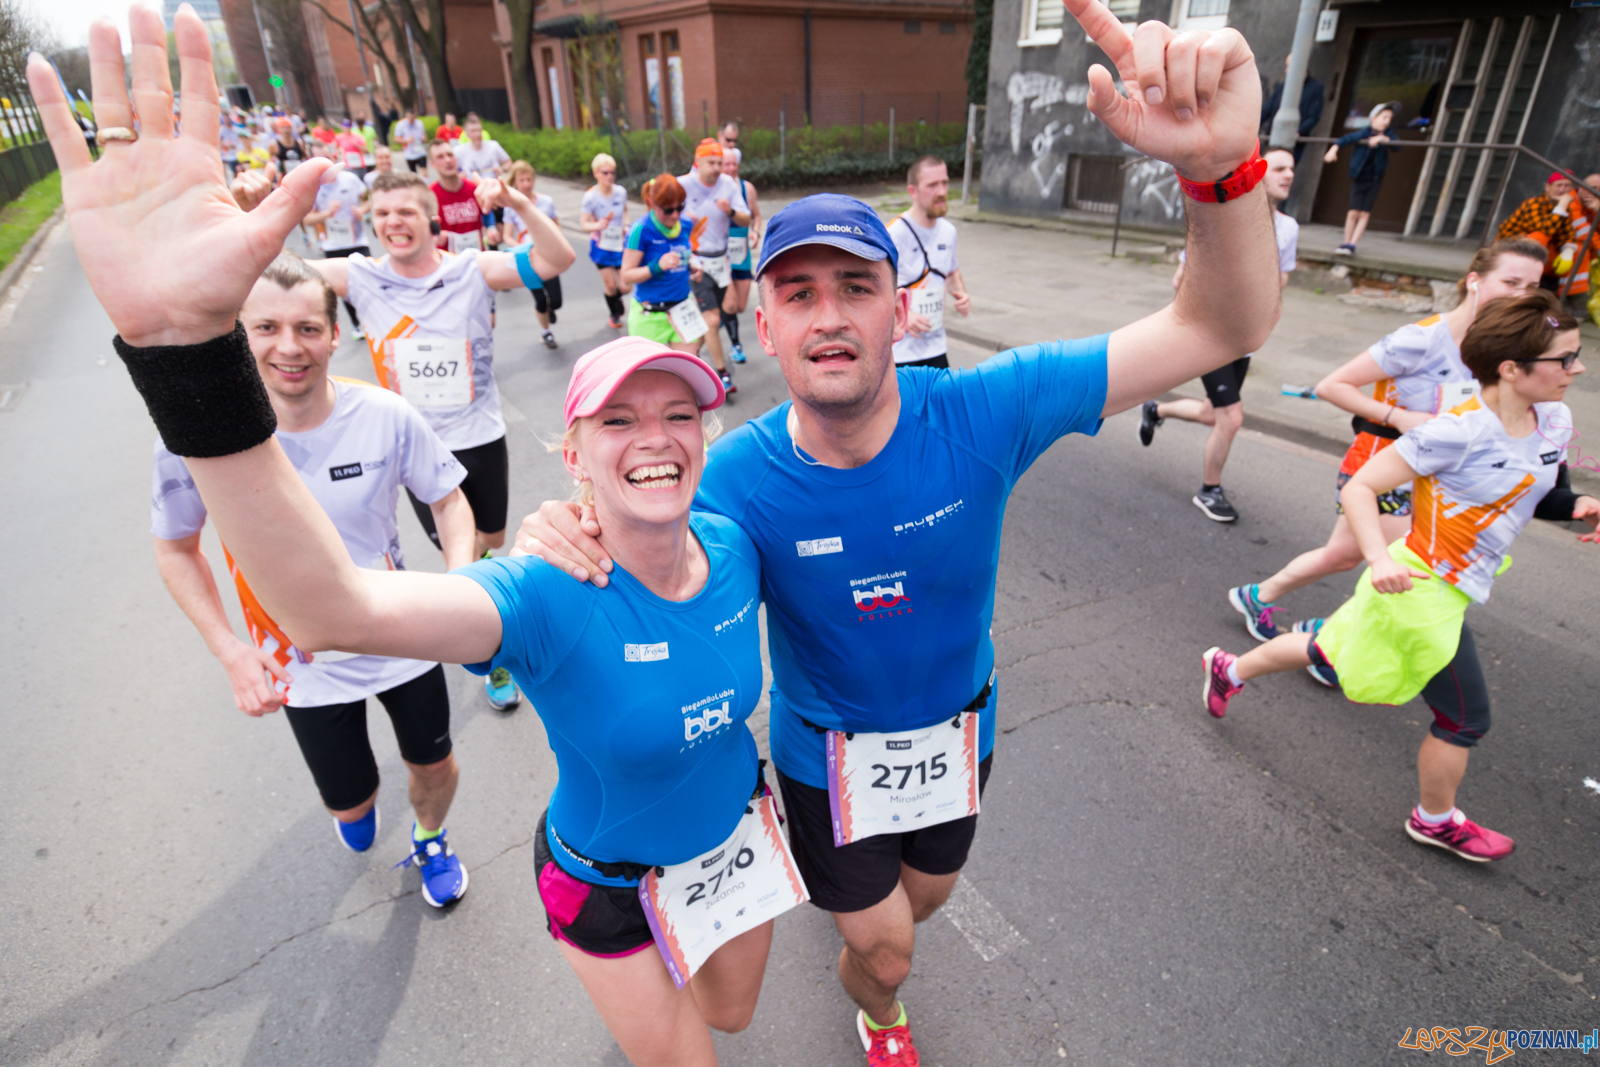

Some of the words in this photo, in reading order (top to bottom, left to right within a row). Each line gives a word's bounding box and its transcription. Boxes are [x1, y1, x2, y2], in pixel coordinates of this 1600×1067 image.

[816, 224, 852, 233] Reebok
[409, 361, 459, 378] 5667
[853, 581, 911, 612] bbl
[858, 607, 914, 622] POLSKA
[684, 701, 733, 741] bbl
[871, 752, 948, 790] 2715
[705, 881, 746, 910] Zuzanna
